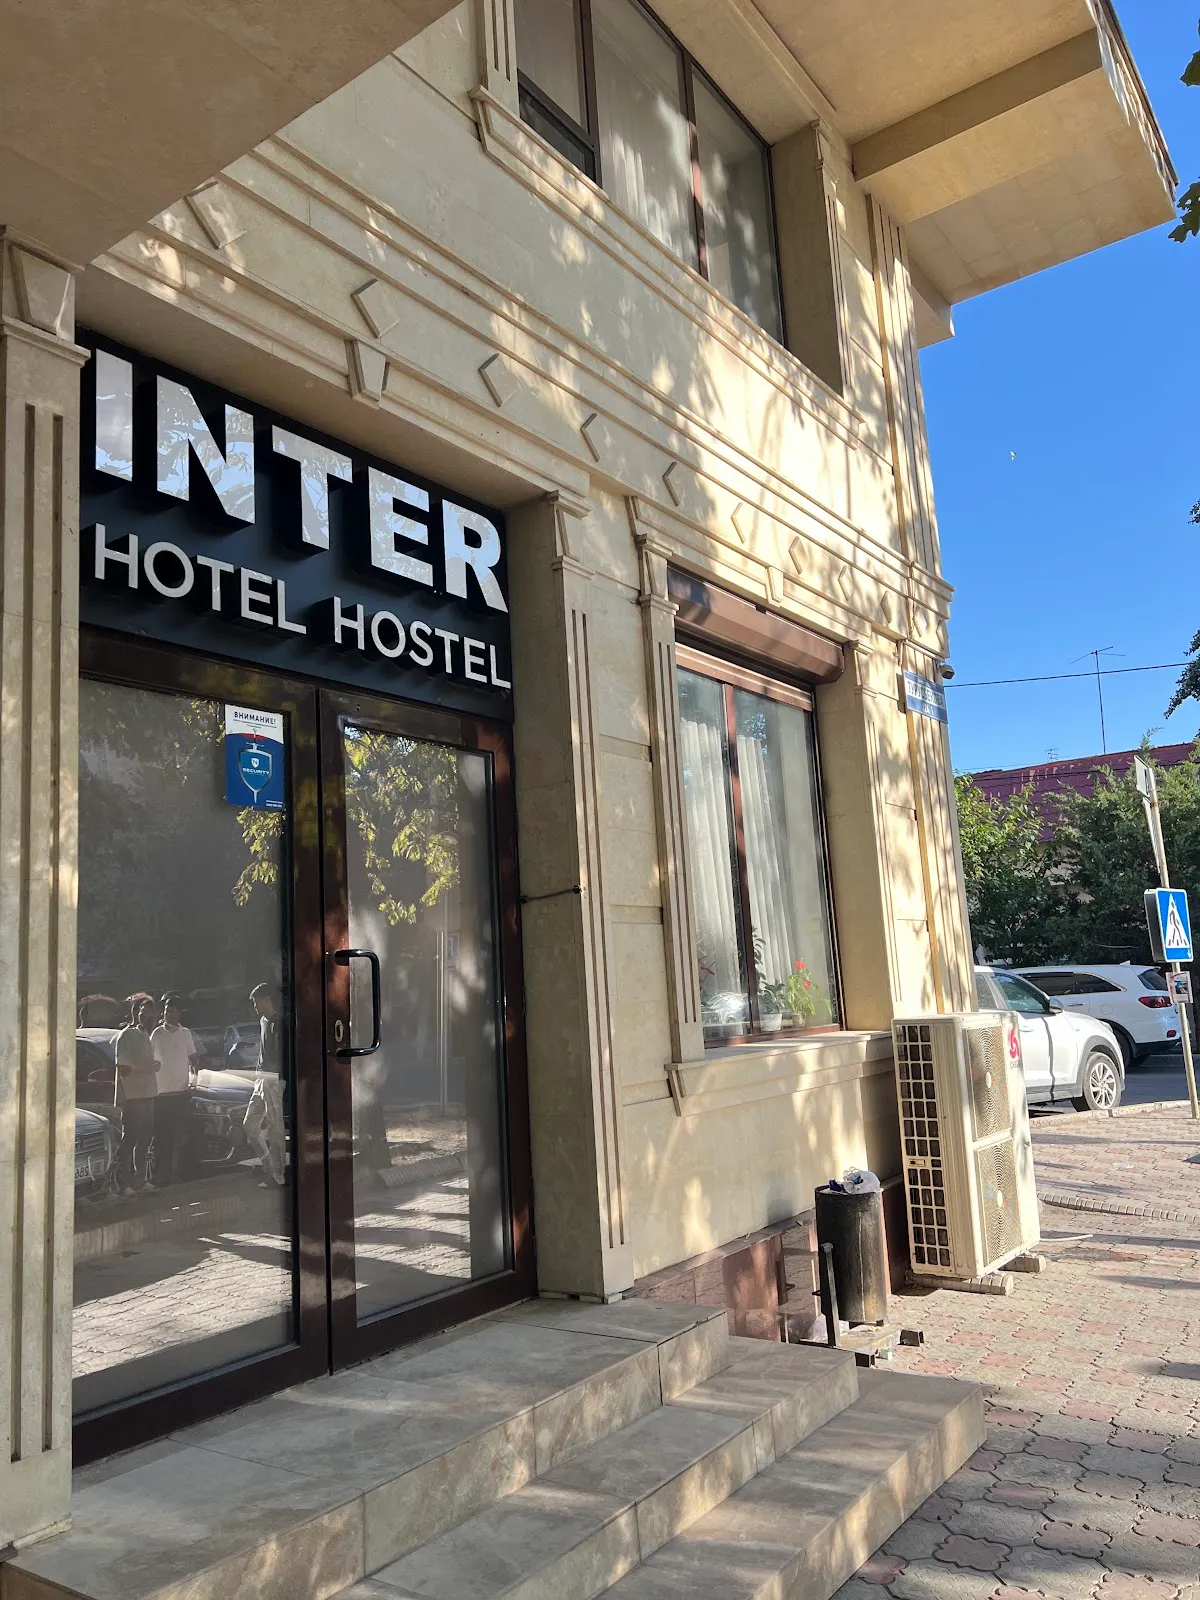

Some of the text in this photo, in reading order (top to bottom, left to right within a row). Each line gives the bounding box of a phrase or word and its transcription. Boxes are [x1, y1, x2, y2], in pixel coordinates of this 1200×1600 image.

[96, 348, 508, 613] INTER
[95, 523, 512, 690] HOTEL HOSTEL
[233, 711, 277, 725] ВНИМАНИЕ!
[242, 767, 270, 775] SECURITY
